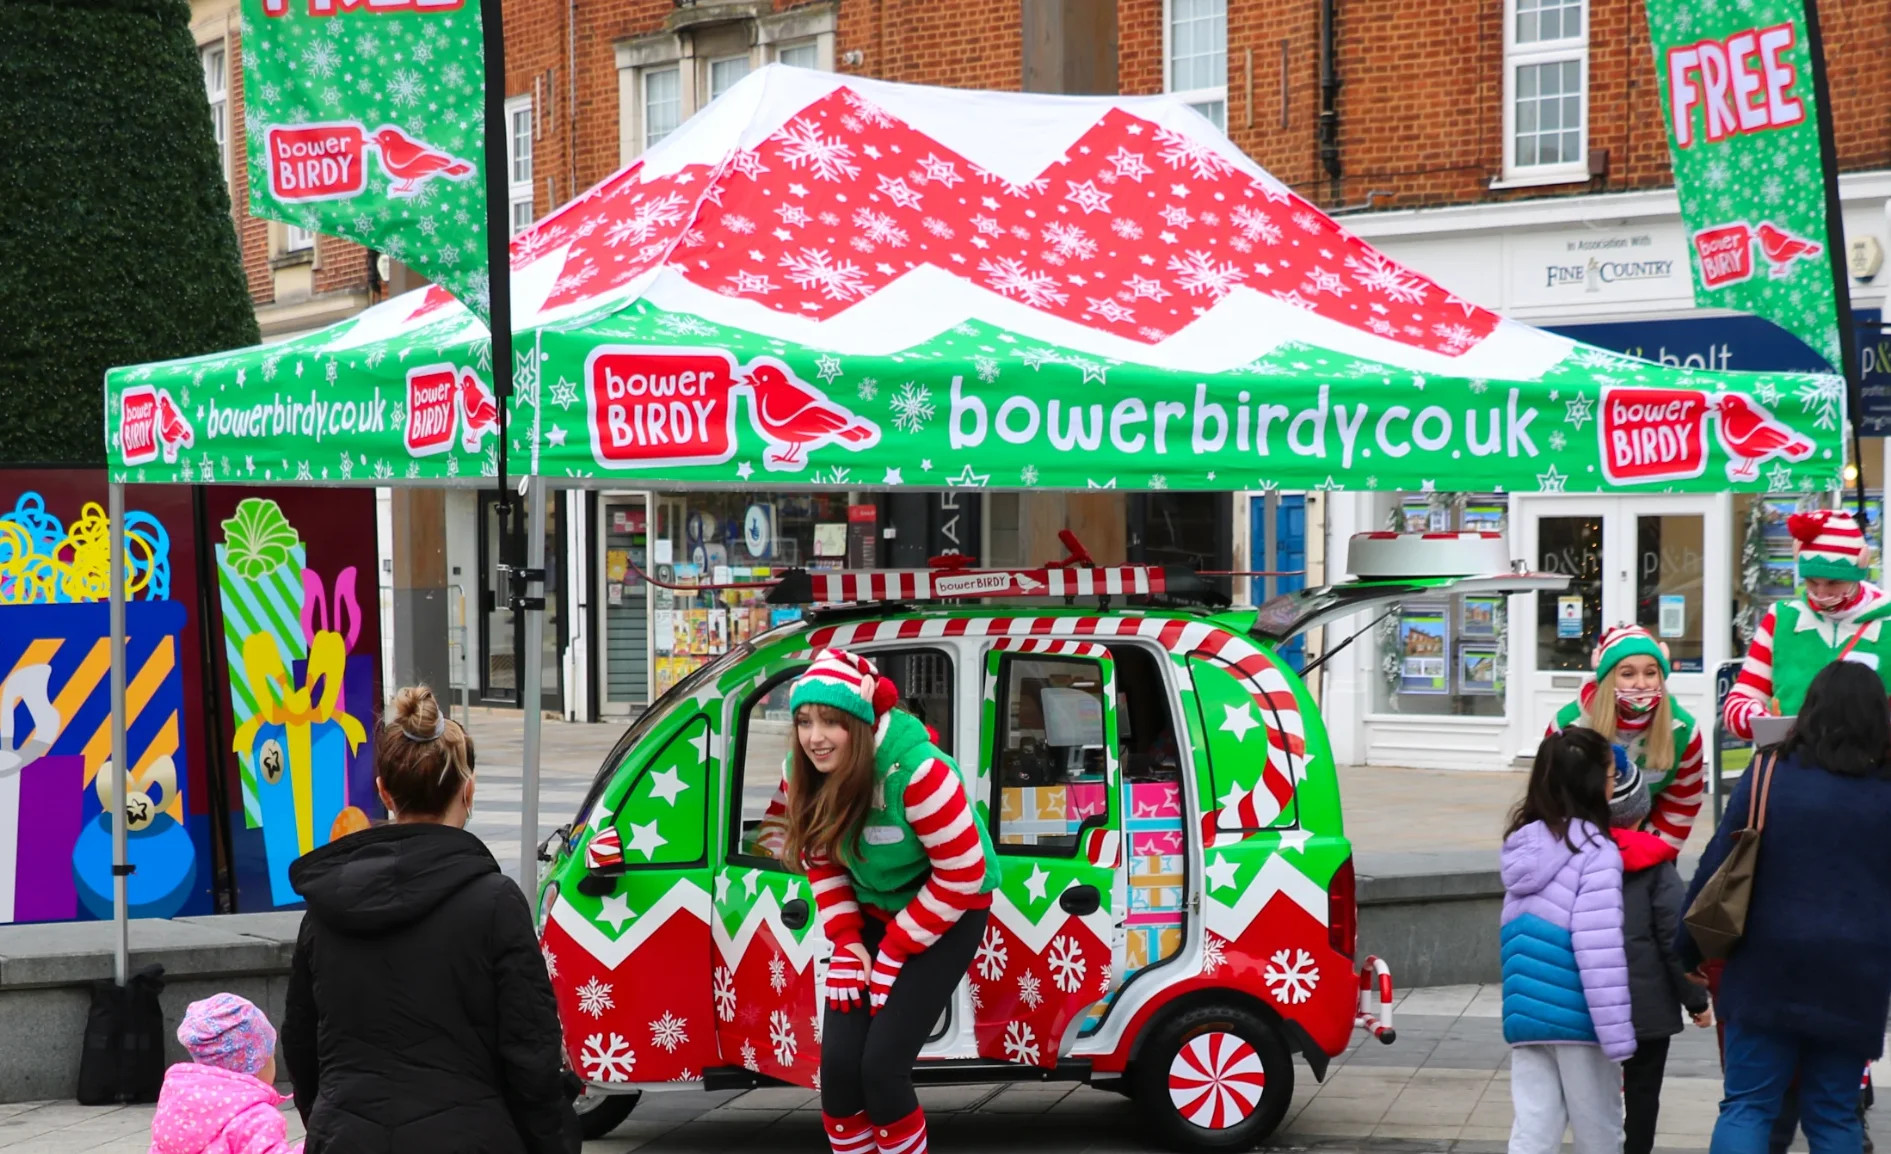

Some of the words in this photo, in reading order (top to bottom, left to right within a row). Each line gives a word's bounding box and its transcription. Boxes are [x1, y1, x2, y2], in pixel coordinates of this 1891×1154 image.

[1669, 26, 1804, 147] FREE
[277, 137, 351, 158] bower
[280, 154, 353, 189] BIRDY
[1578, 237, 1628, 250] Association
[1631, 235, 1652, 246] With
[414, 382, 450, 407] bower
[605, 367, 715, 400] bower
[126, 402, 153, 422] bower
[207, 386, 386, 443] bowerbirdy.co.uk
[412, 402, 450, 440] BIRDY
[608, 399, 716, 447] BIRDY
[949, 376, 1539, 469] bowerbirdy.co.uk
[1613, 399, 1696, 426] bower
[125, 418, 152, 450] BIRDY
[1612, 422, 1694, 467] BIRDY
[940, 576, 1006, 592] bowerBIRDY
